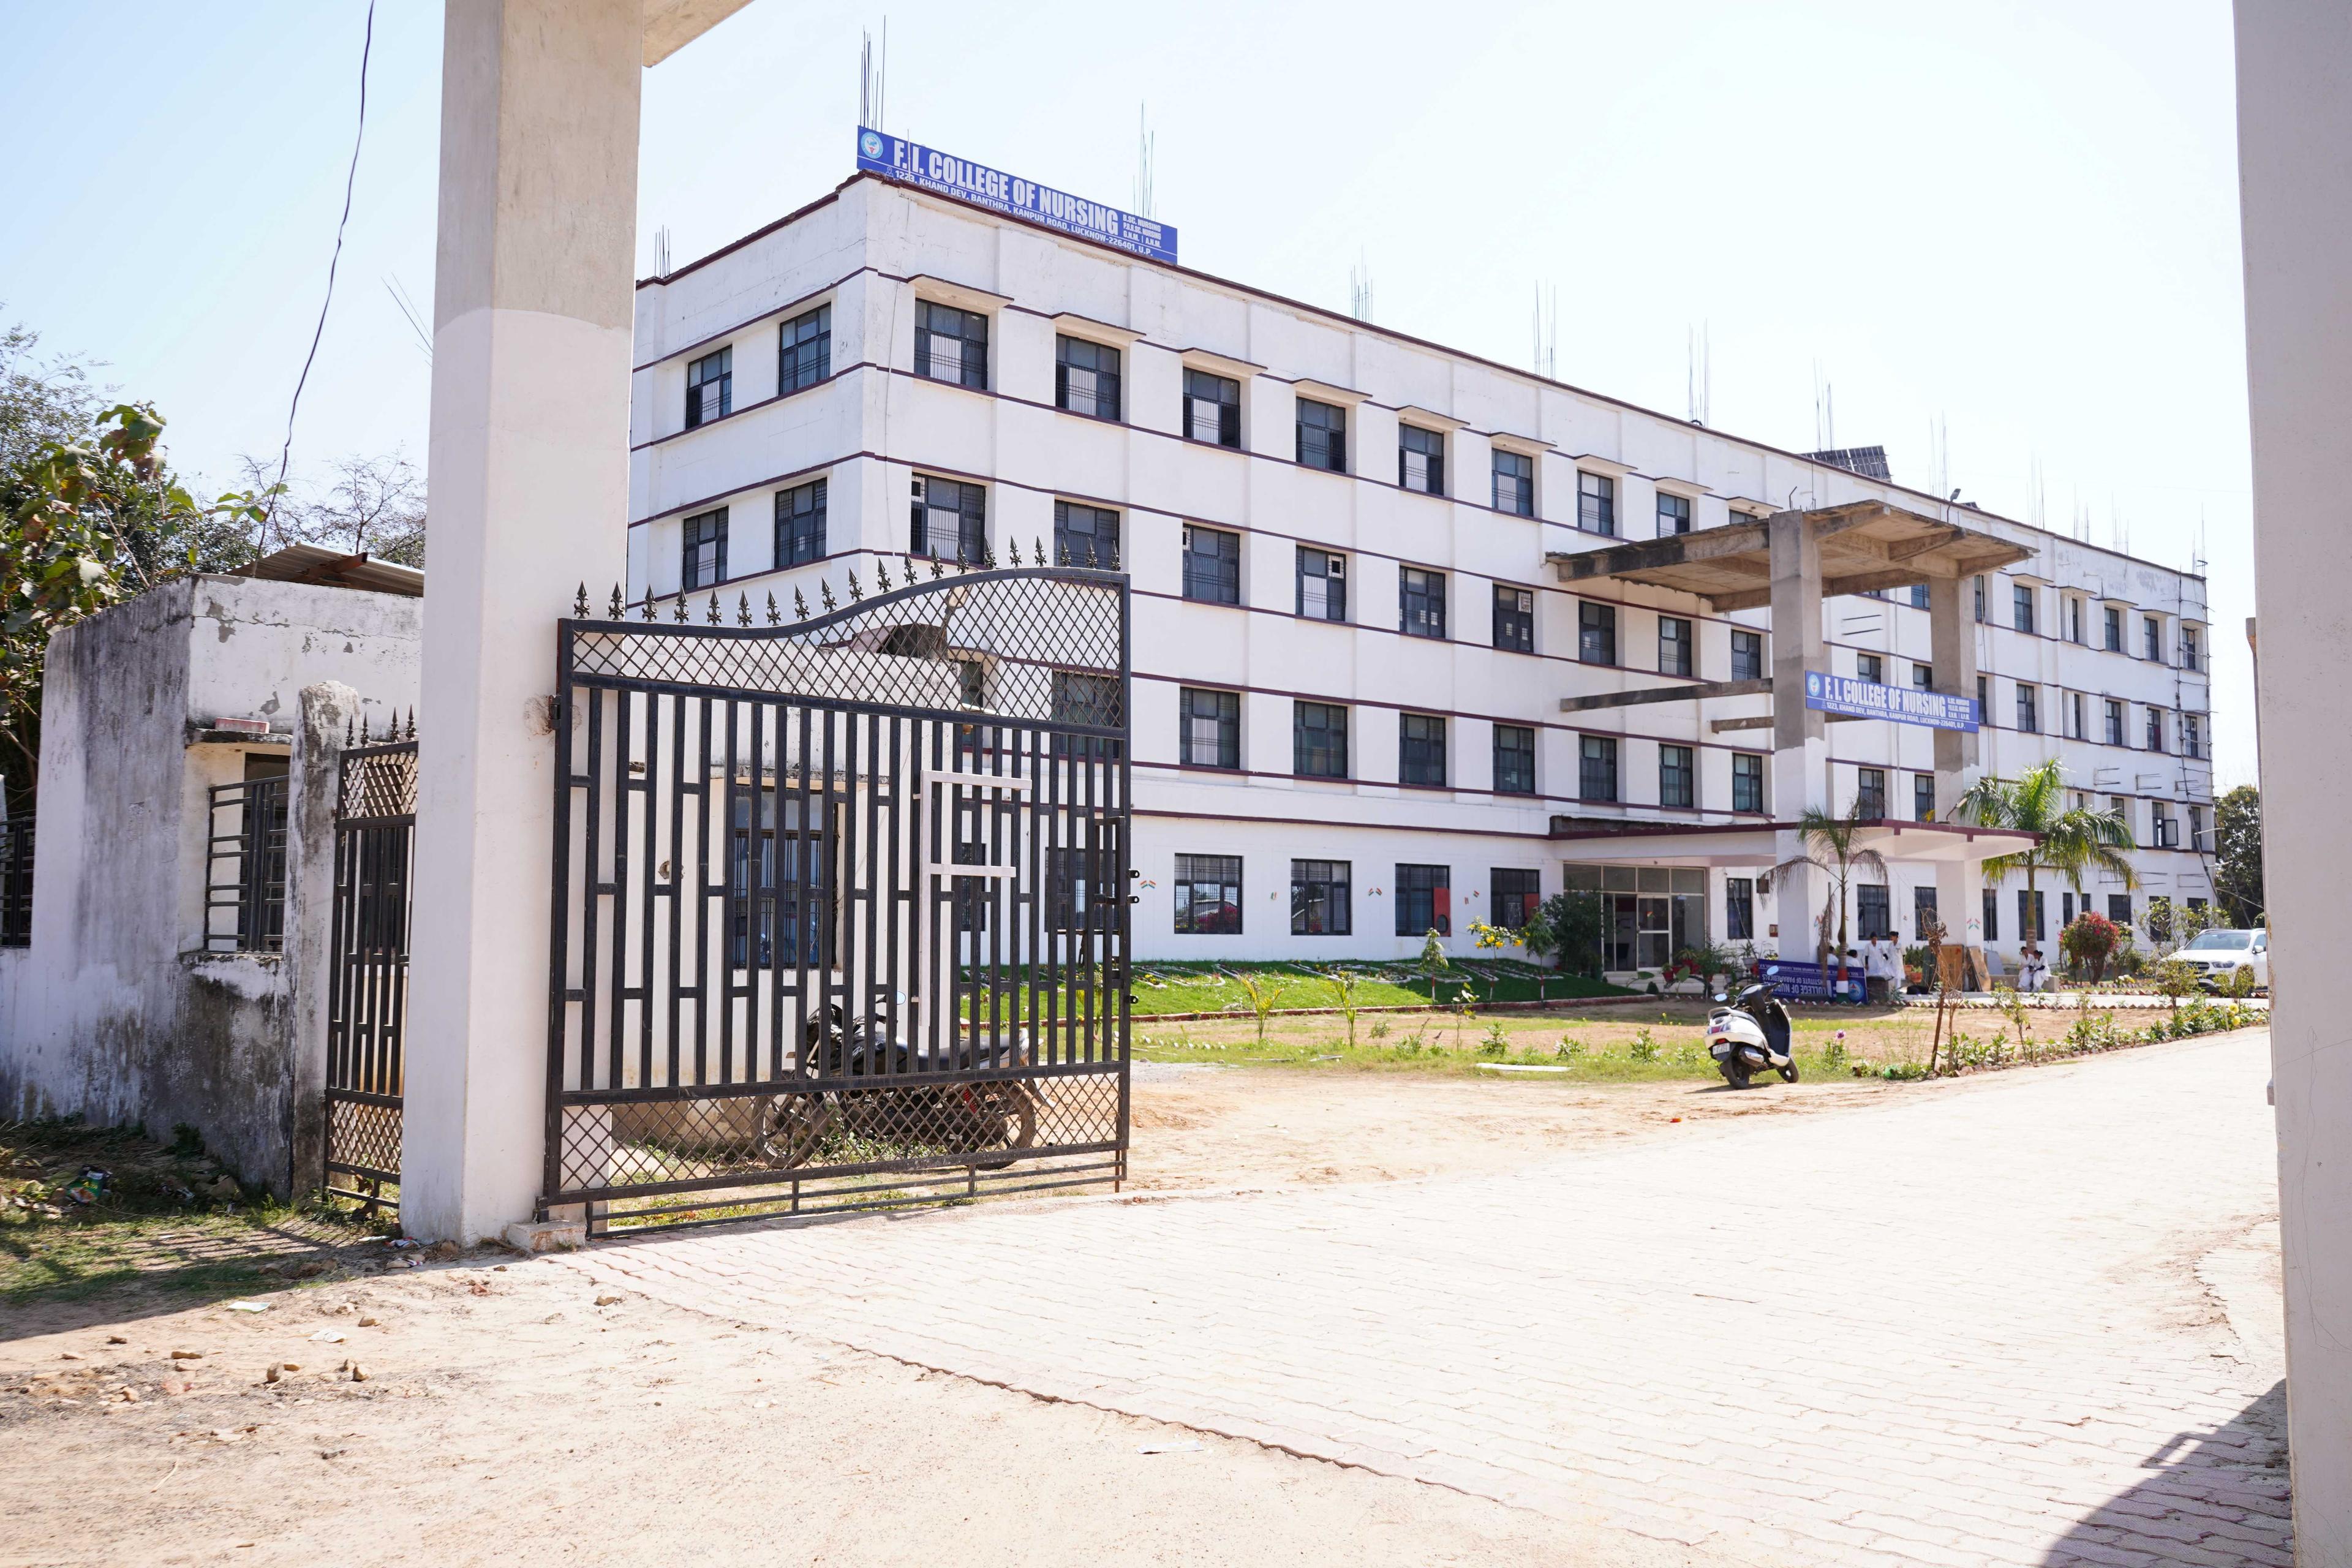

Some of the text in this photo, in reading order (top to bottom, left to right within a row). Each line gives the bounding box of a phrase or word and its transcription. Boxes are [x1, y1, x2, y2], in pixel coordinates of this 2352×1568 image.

[894, 140, 907, 169] F.
[912, 146, 924, 175] I.
[929, 152, 1009, 201] COLLEGE
[1012, 179, 1036, 208] OF
[1039, 187, 1118, 236] NURSING
[919, 178, 949, 193] KHAND
[971, 194, 1012, 213] BANTHRA,
[1013, 206, 1045, 223] KANPUR
[1047, 217, 1069, 232] ROAD,
[1139, 246, 1153, 256] U.P.
[1137, 219, 1161, 232] NURSING
[1844, 679, 1887, 708] COLLEGE
[1888, 687, 1901, 710] OF
[1902, 690, 1946, 717] NURSING
[1792, 984, 1800, 993] OF
